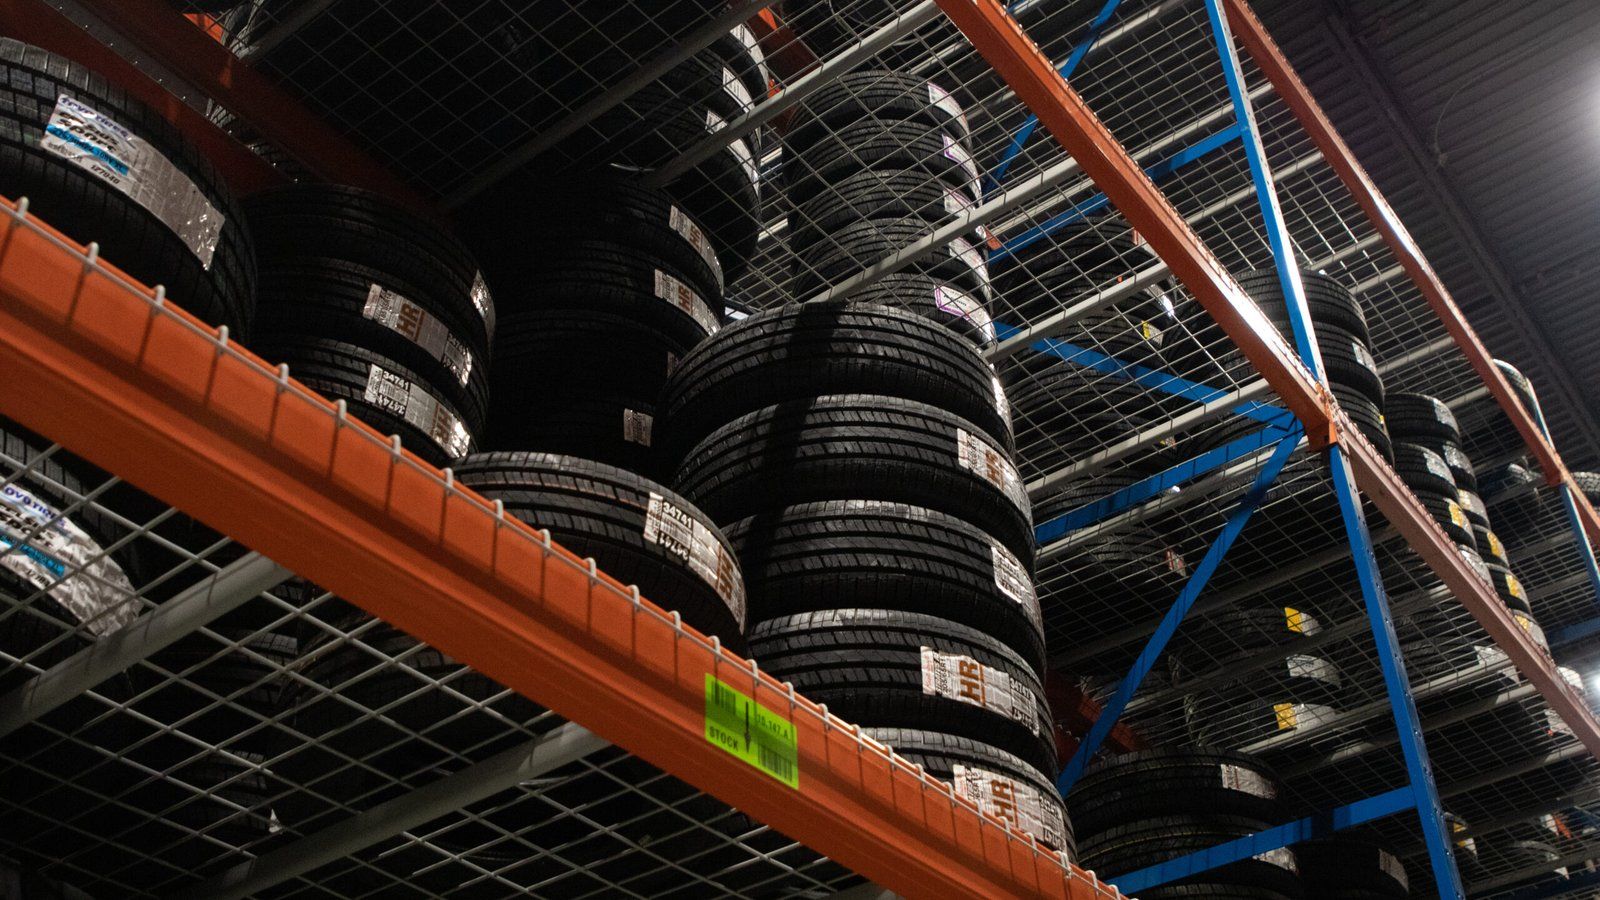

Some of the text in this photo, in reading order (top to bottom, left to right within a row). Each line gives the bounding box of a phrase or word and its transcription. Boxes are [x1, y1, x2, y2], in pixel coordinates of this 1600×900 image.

[396, 302, 421, 338] HR
[383, 371, 409, 391] 34741
[377, 394, 405, 414] 34741
[662, 501, 693, 529] 34741
[659, 532, 690, 561] 34741
[959, 659, 981, 702] HR
[709, 725, 739, 752] STOCK
[991, 778, 1014, 822] HR
